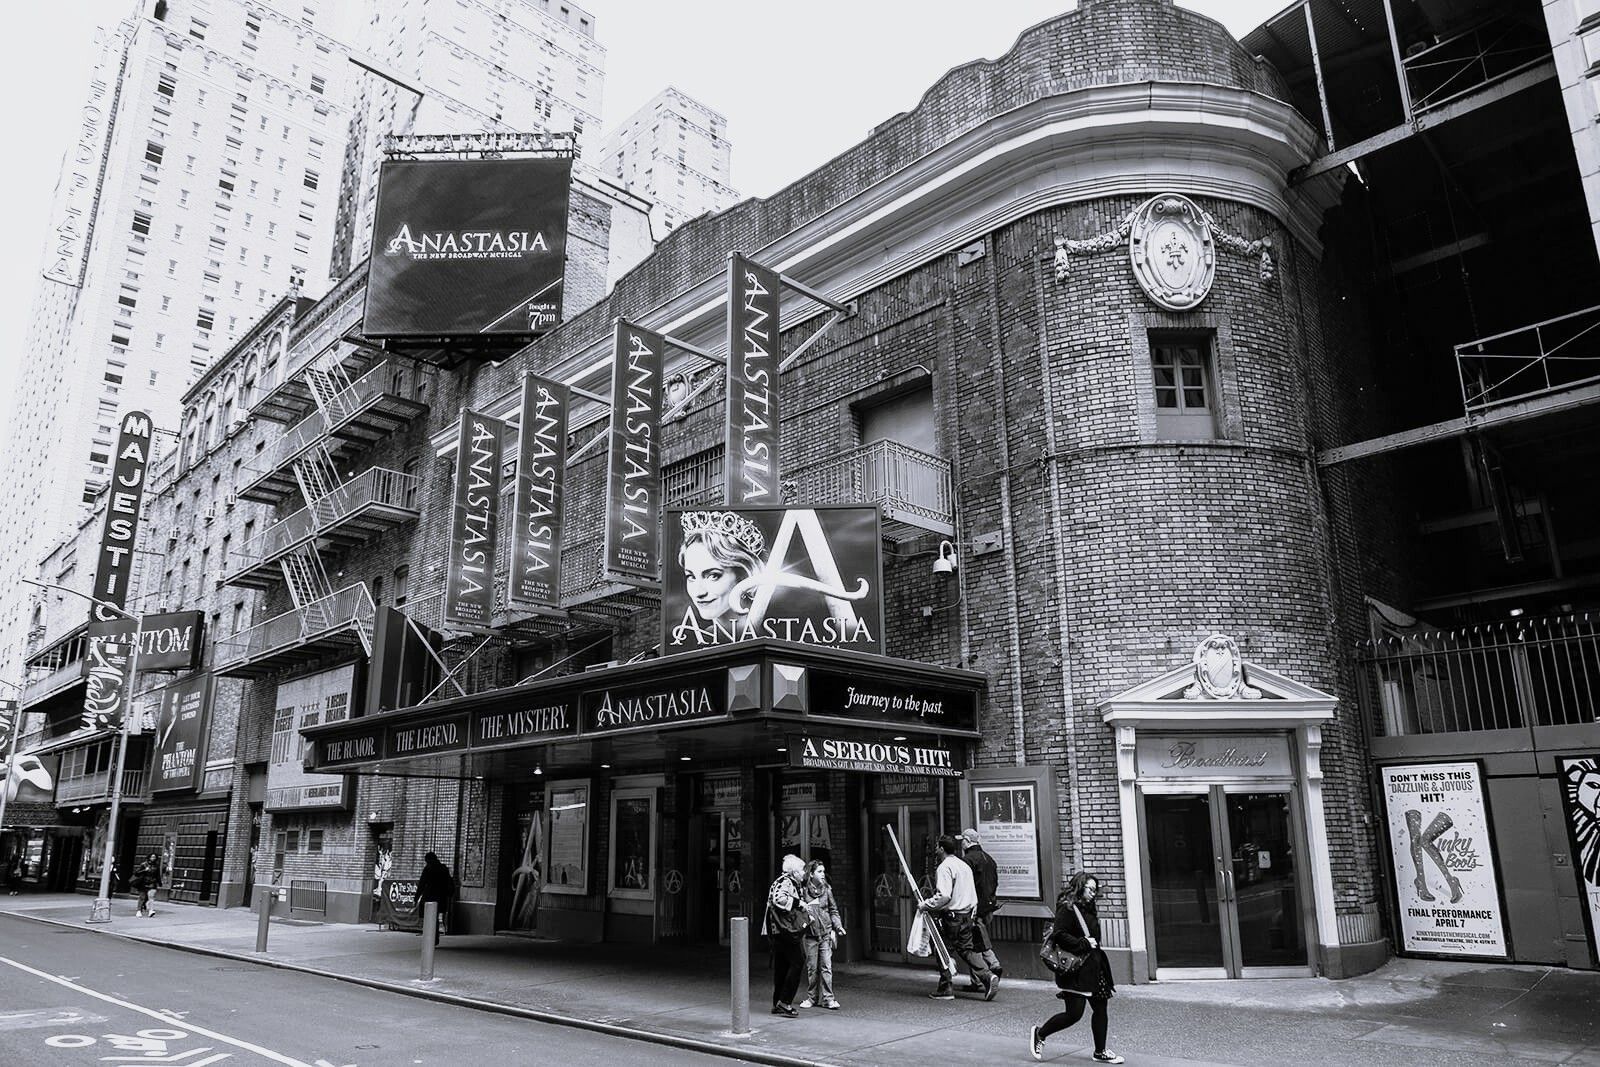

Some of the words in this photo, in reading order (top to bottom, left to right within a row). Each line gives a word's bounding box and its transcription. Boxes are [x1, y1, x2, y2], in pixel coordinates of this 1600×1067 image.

[384, 224, 548, 253] ANASTASIA
[528, 303, 551, 311] Tonight
[528, 312, 556, 330] 7pm
[742, 270, 770, 502] ANASTASIA
[622, 333, 654, 541] ANASTASIA
[526, 385, 560, 574] ANASTASIA
[459, 421, 496, 598] ANASTASIA
[94, 415, 149, 621] MAJESTIC
[618, 553, 649, 565] BROADWAY
[620, 547, 633, 556] THE
[634, 549, 647, 558] NEW
[620, 559, 648, 570] MUSICAL
[521, 584, 550, 595] BROADWAY
[536, 581, 549, 589] NEW
[523, 590, 548, 600] MUSICAL
[455, 605, 484, 615] BROADWAY
[469, 602, 482, 610] NEW
[457, 611, 481, 620] MUSICAL
[670, 605, 876, 646] ANASTASIA
[597, 687, 713, 728] ANASTASIA
[844, 687, 890, 712] Journey
[892, 695, 902, 709] to
[904, 694, 921, 712] the
[920, 699, 944, 717] past.
[480, 715, 503, 740] THE
[507, 704, 570, 738] MYSTERY.
[396, 730, 415, 752] THE
[416, 723, 459, 749] LEGEND.
[327, 743, 341, 761] THE
[342, 737, 376, 760] RUMOR.
[823, 740, 911, 765] SERIOUS
[914, 748, 952, 767] HIT!
[1161, 742, 1269, 769] Broadhurst
[162, 748, 197, 770] PHANTOM
[837, 760, 849, 770] GOT
[854, 761, 872, 770] BRIGHT
[886, 764, 899, 773] STAR
[1390, 773, 1418, 783] DON'T
[1420, 773, 1445, 782] MISS
[1447, 771, 1471, 780] THIS
[1431, 781, 1439, 792] &
[1420, 793, 1445, 803] HIT!
[1446, 853, 1484, 869] Boots
[1408, 908, 1431, 918] FINAL
[1432, 909, 1492, 920] PERFORMANCE
[1436, 918, 1459, 928] APRIL
[1460, 919, 1465, 928] 7
